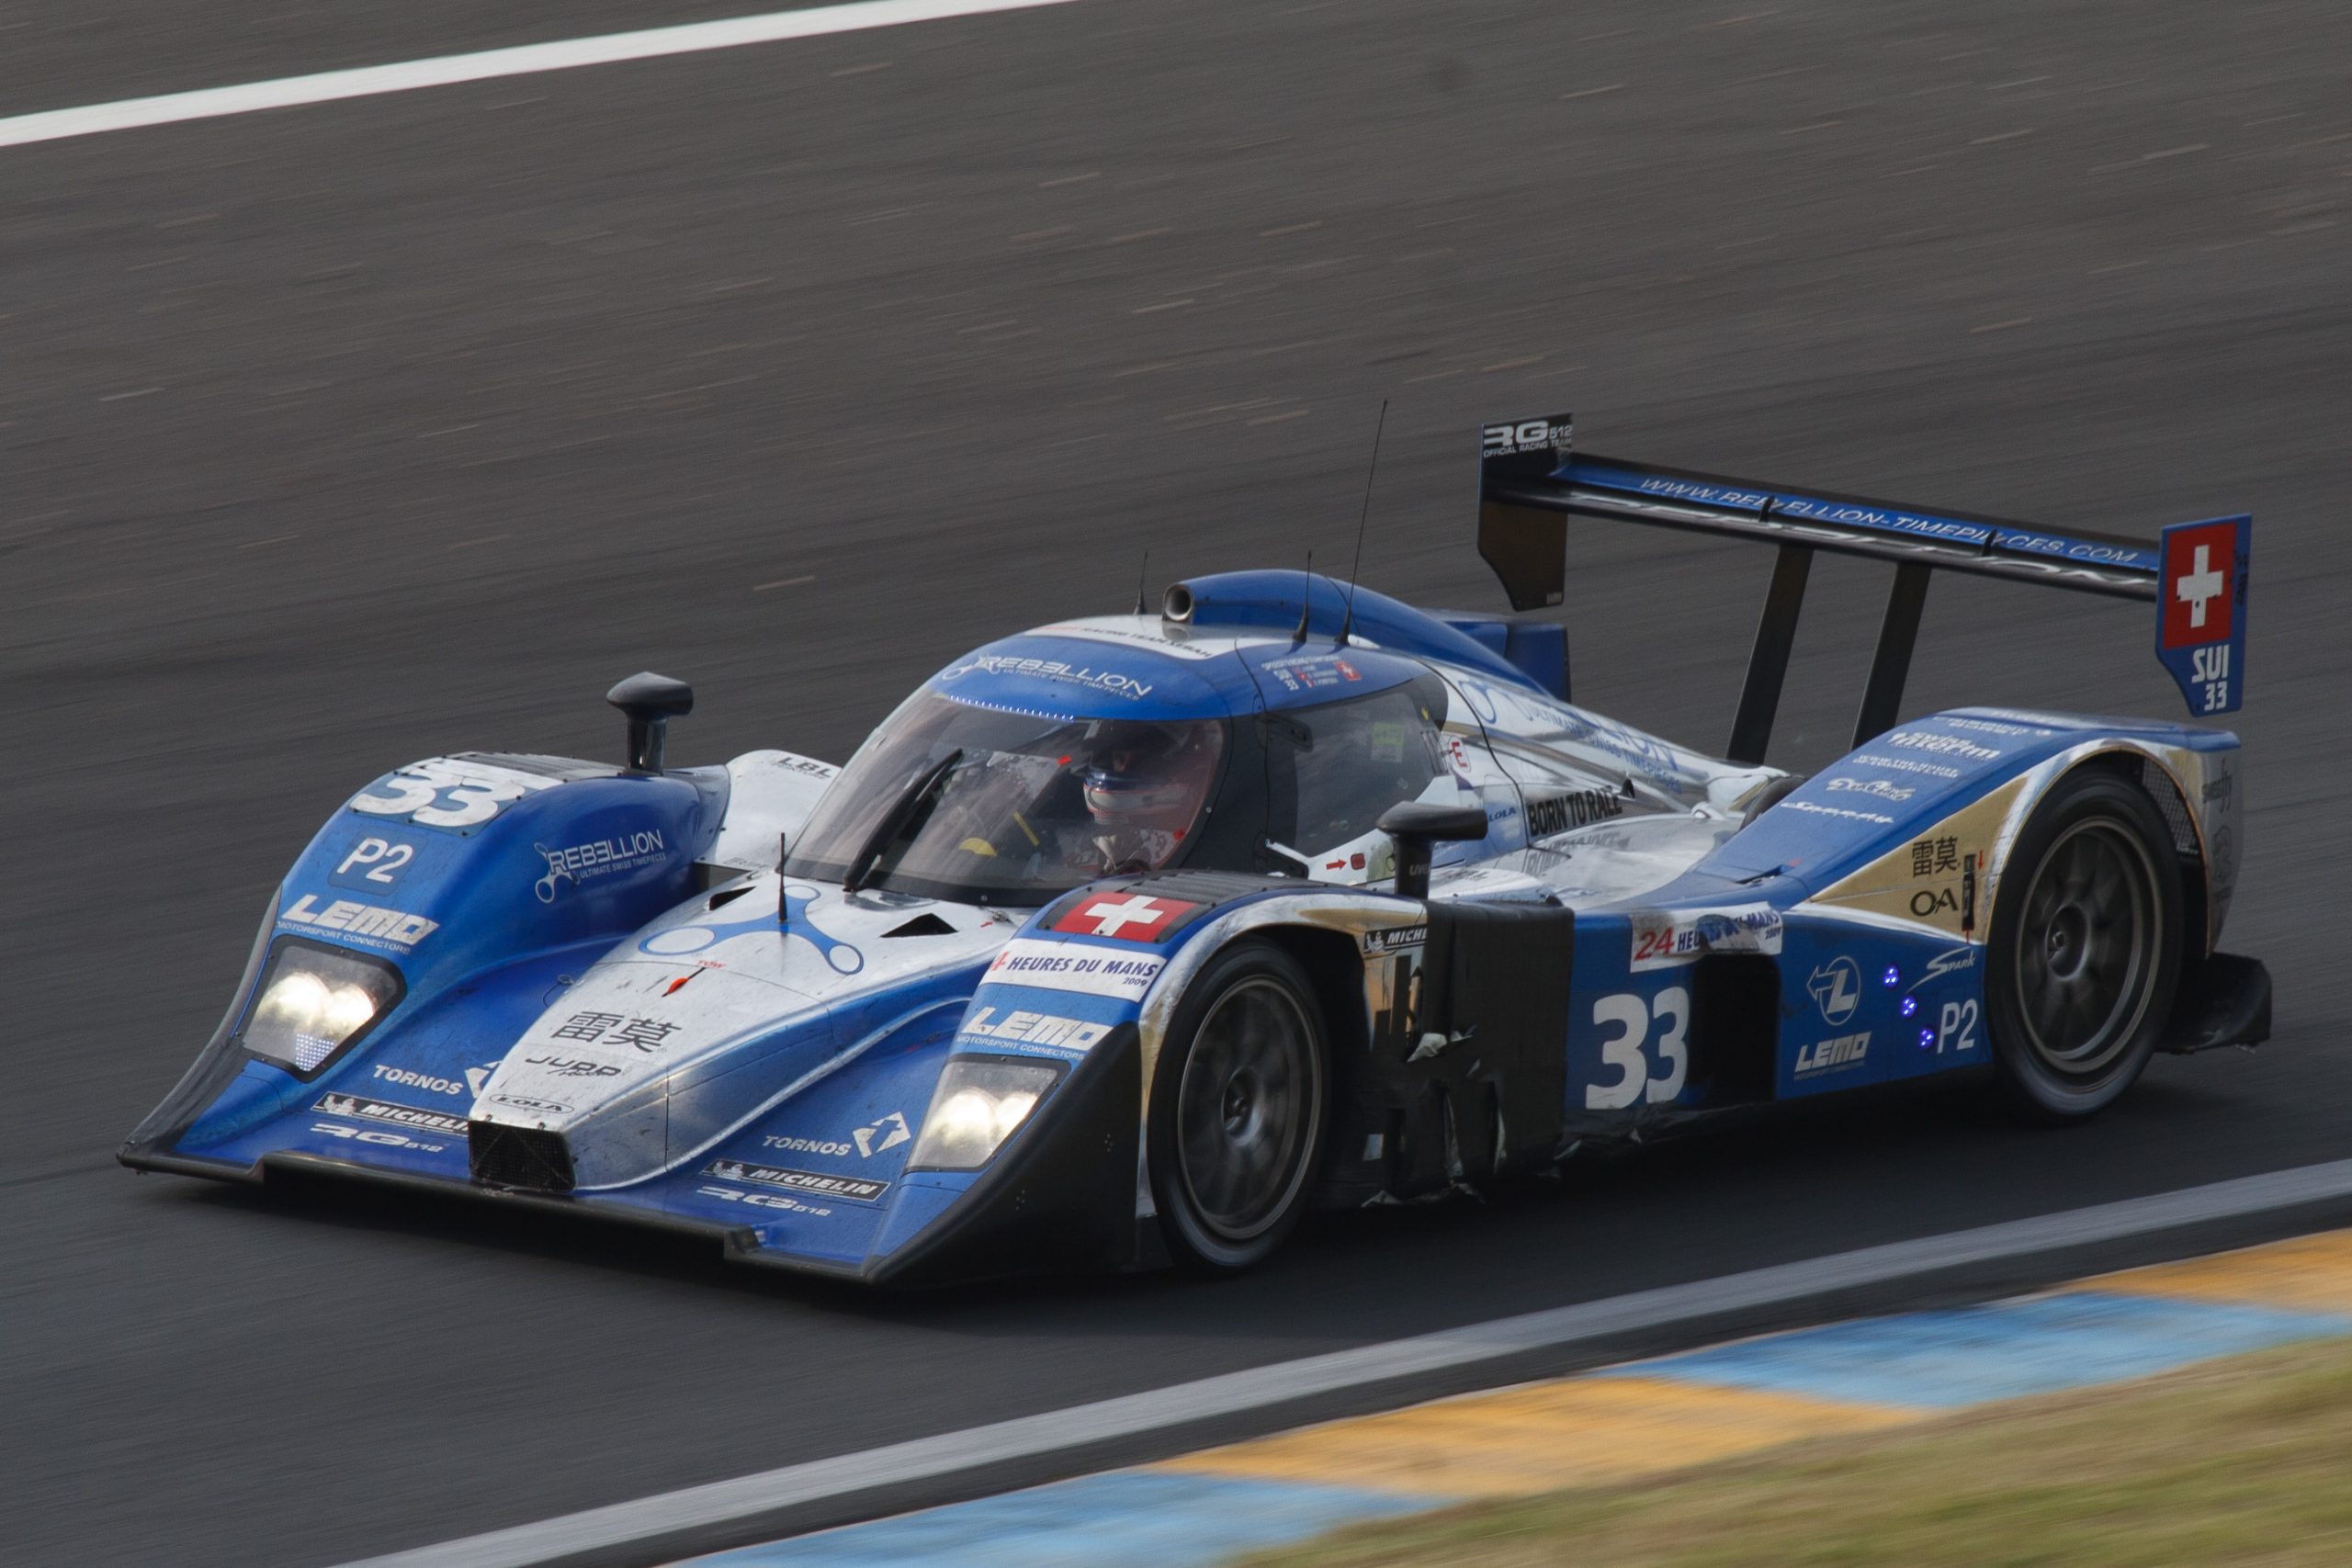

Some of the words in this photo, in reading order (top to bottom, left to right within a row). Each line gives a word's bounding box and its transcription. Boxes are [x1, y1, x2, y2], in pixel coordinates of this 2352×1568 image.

[1483, 445, 1517, 458] OFFICIAL
[1519, 440, 1549, 451] RACING
[2191, 644, 2231, 683] SUI
[2203, 681, 2228, 712] 33
[349, 765, 526, 828] 33
[1488, 807, 1517, 823] LOLA
[1527, 796, 1567, 837] BORN
[1566, 792, 1587, 826] TO
[336, 837, 413, 884] P2
[580, 866, 611, 879] ULTIMATE
[612, 861, 632, 873] SWISS
[632, 852, 667, 868] TIMEPIECES
[1911, 836, 1958, 878] 雷莫
[282, 893, 441, 946] LEMO
[277, 920, 343, 941] MOTORSPORT
[343, 931, 412, 955] CONNECTORS
[1634, 926, 1676, 962] 24
[1007, 956, 1070, 972] HEURES
[1073, 958, 1101, 973] DU
[1102, 960, 1159, 977] MANS
[1122, 976, 1148, 987] 2009
[549, 1010, 682, 1054] 雷莫
[961, 1006, 1114, 1052] LEMO
[1937, 998, 1979, 1055] P2
[956, 1035, 1019, 1051] MOTORSPORT
[1020, 1043, 1085, 1060] CONNECTORS
[1585, 986, 1690, 1110] 33
[1794, 1031, 1872, 1073] LEMO
[372, 1064, 464, 1095] TORNOS
[497, 1096, 563, 1112] LOLA
[763, 1134, 853, 1156] TORNOS
[749, 1168, 879, 1195] MICHELIN
